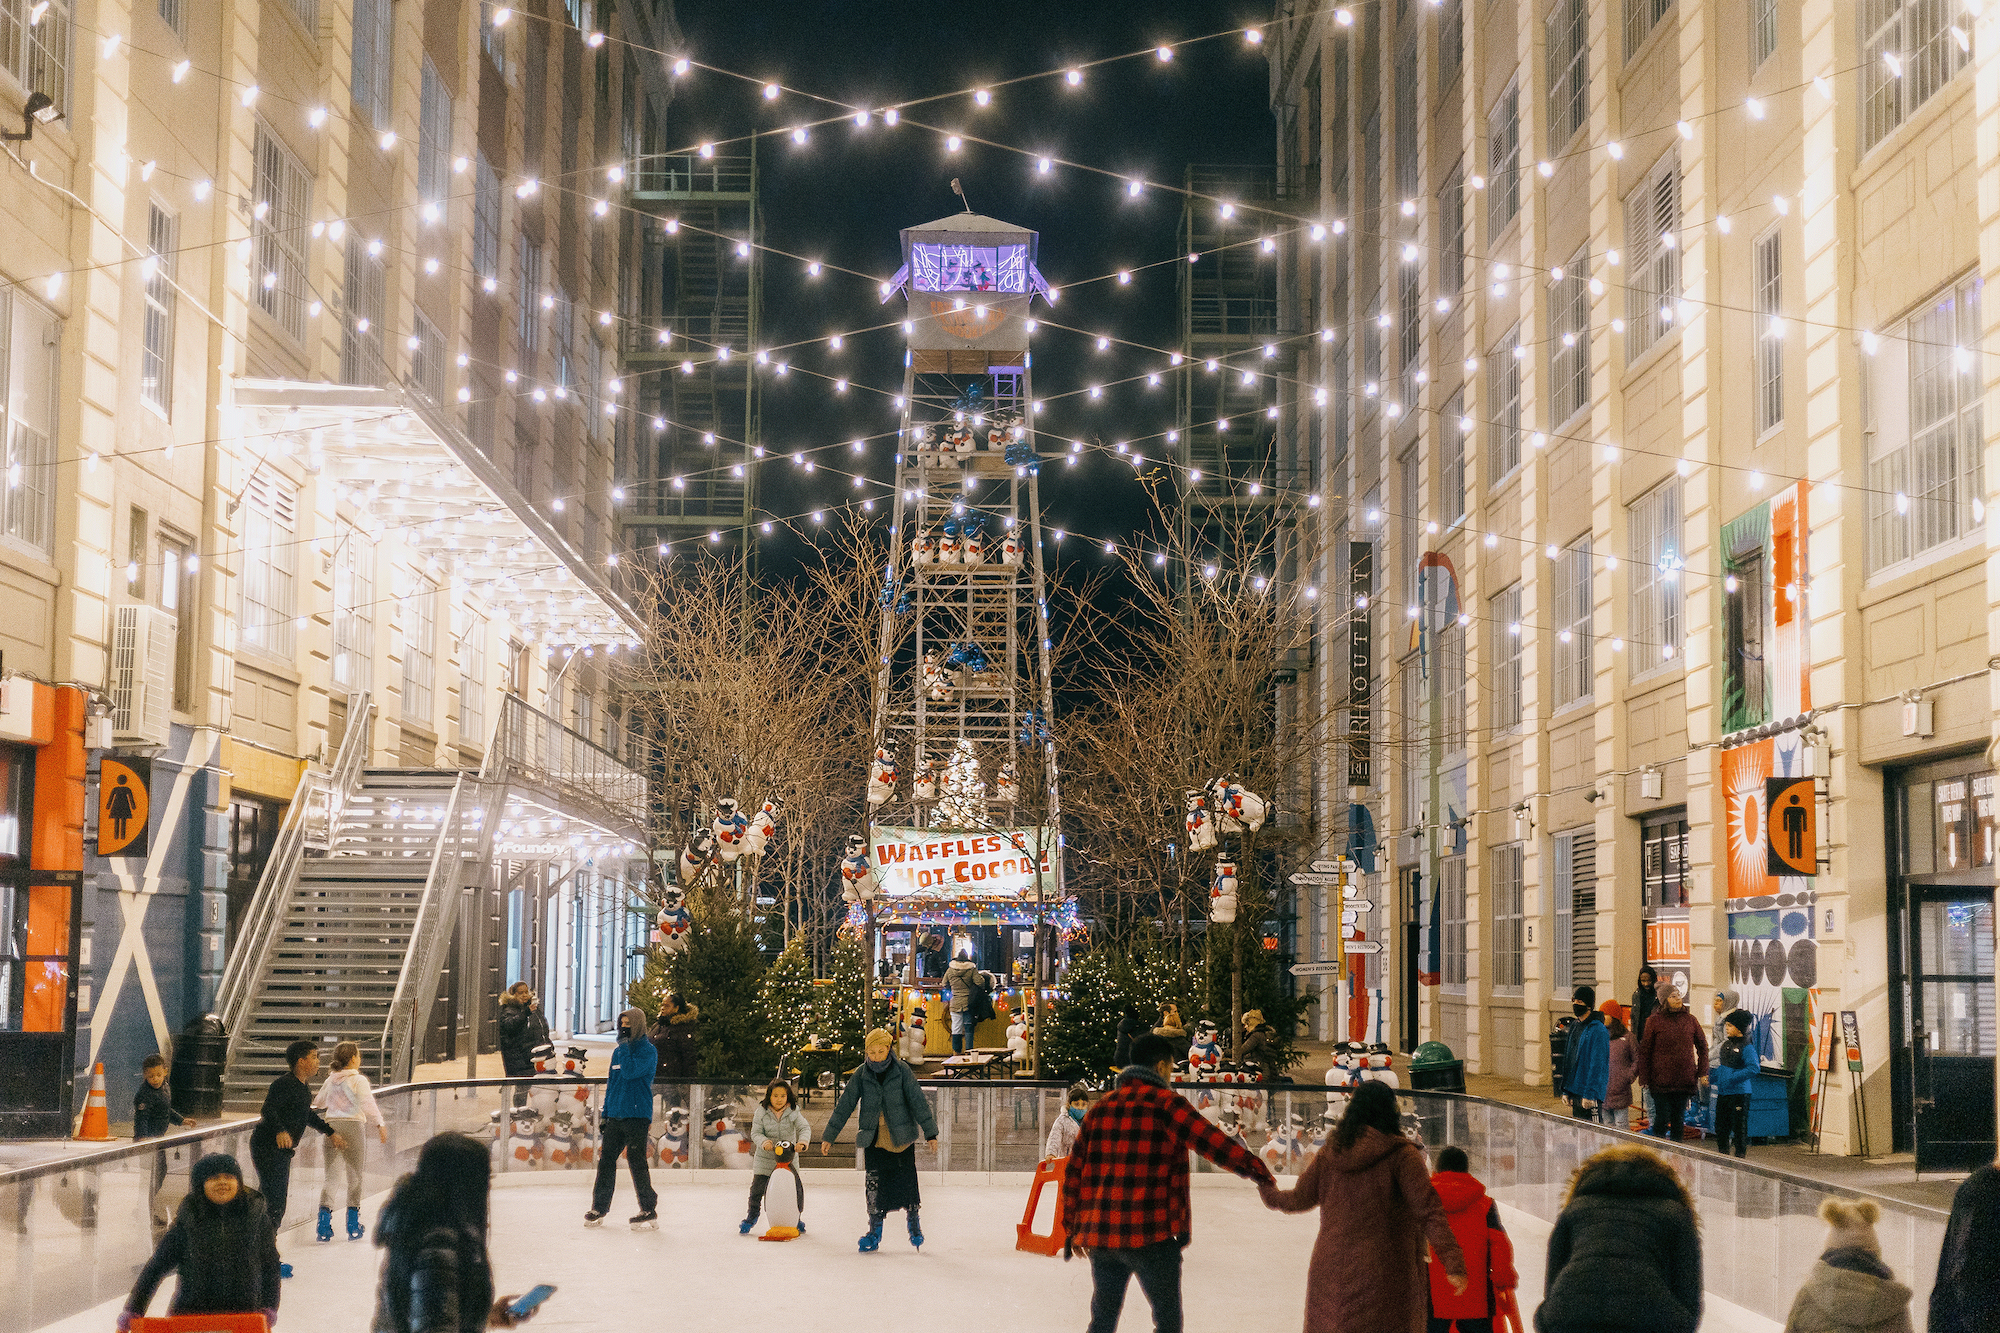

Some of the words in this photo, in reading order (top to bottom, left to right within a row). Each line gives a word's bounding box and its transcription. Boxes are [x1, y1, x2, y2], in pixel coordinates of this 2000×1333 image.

[1353, 568, 1368, 692] OUTLET
[876, 835, 1002, 866] WAFFLES
[1010, 832, 1026, 850] &
[895, 867, 946, 888] HOT
[953, 849, 1051, 884] COCOA!
[1663, 927, 1688, 955] HALL
